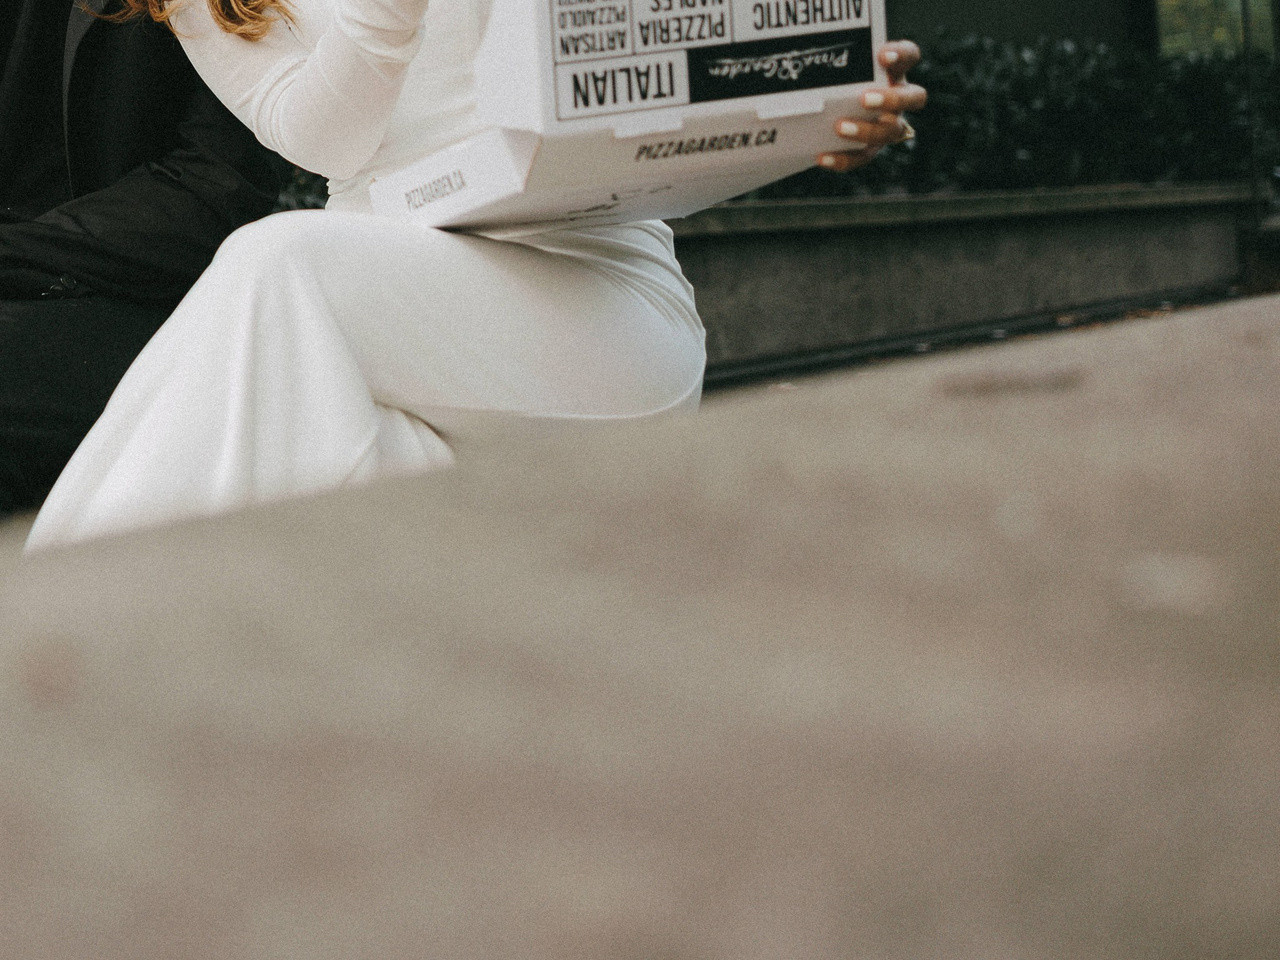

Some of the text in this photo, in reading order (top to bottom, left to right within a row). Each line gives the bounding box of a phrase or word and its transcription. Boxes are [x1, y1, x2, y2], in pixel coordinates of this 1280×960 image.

[560, 31, 627, 55] ARTISAN
[638, 12, 725, 46] PIZZERIA
[572, 61, 675, 109] ITALIAN
[708, 58, 778, 79] Garden
[635, 128, 778, 162] PIZZAGARDEN.CA
